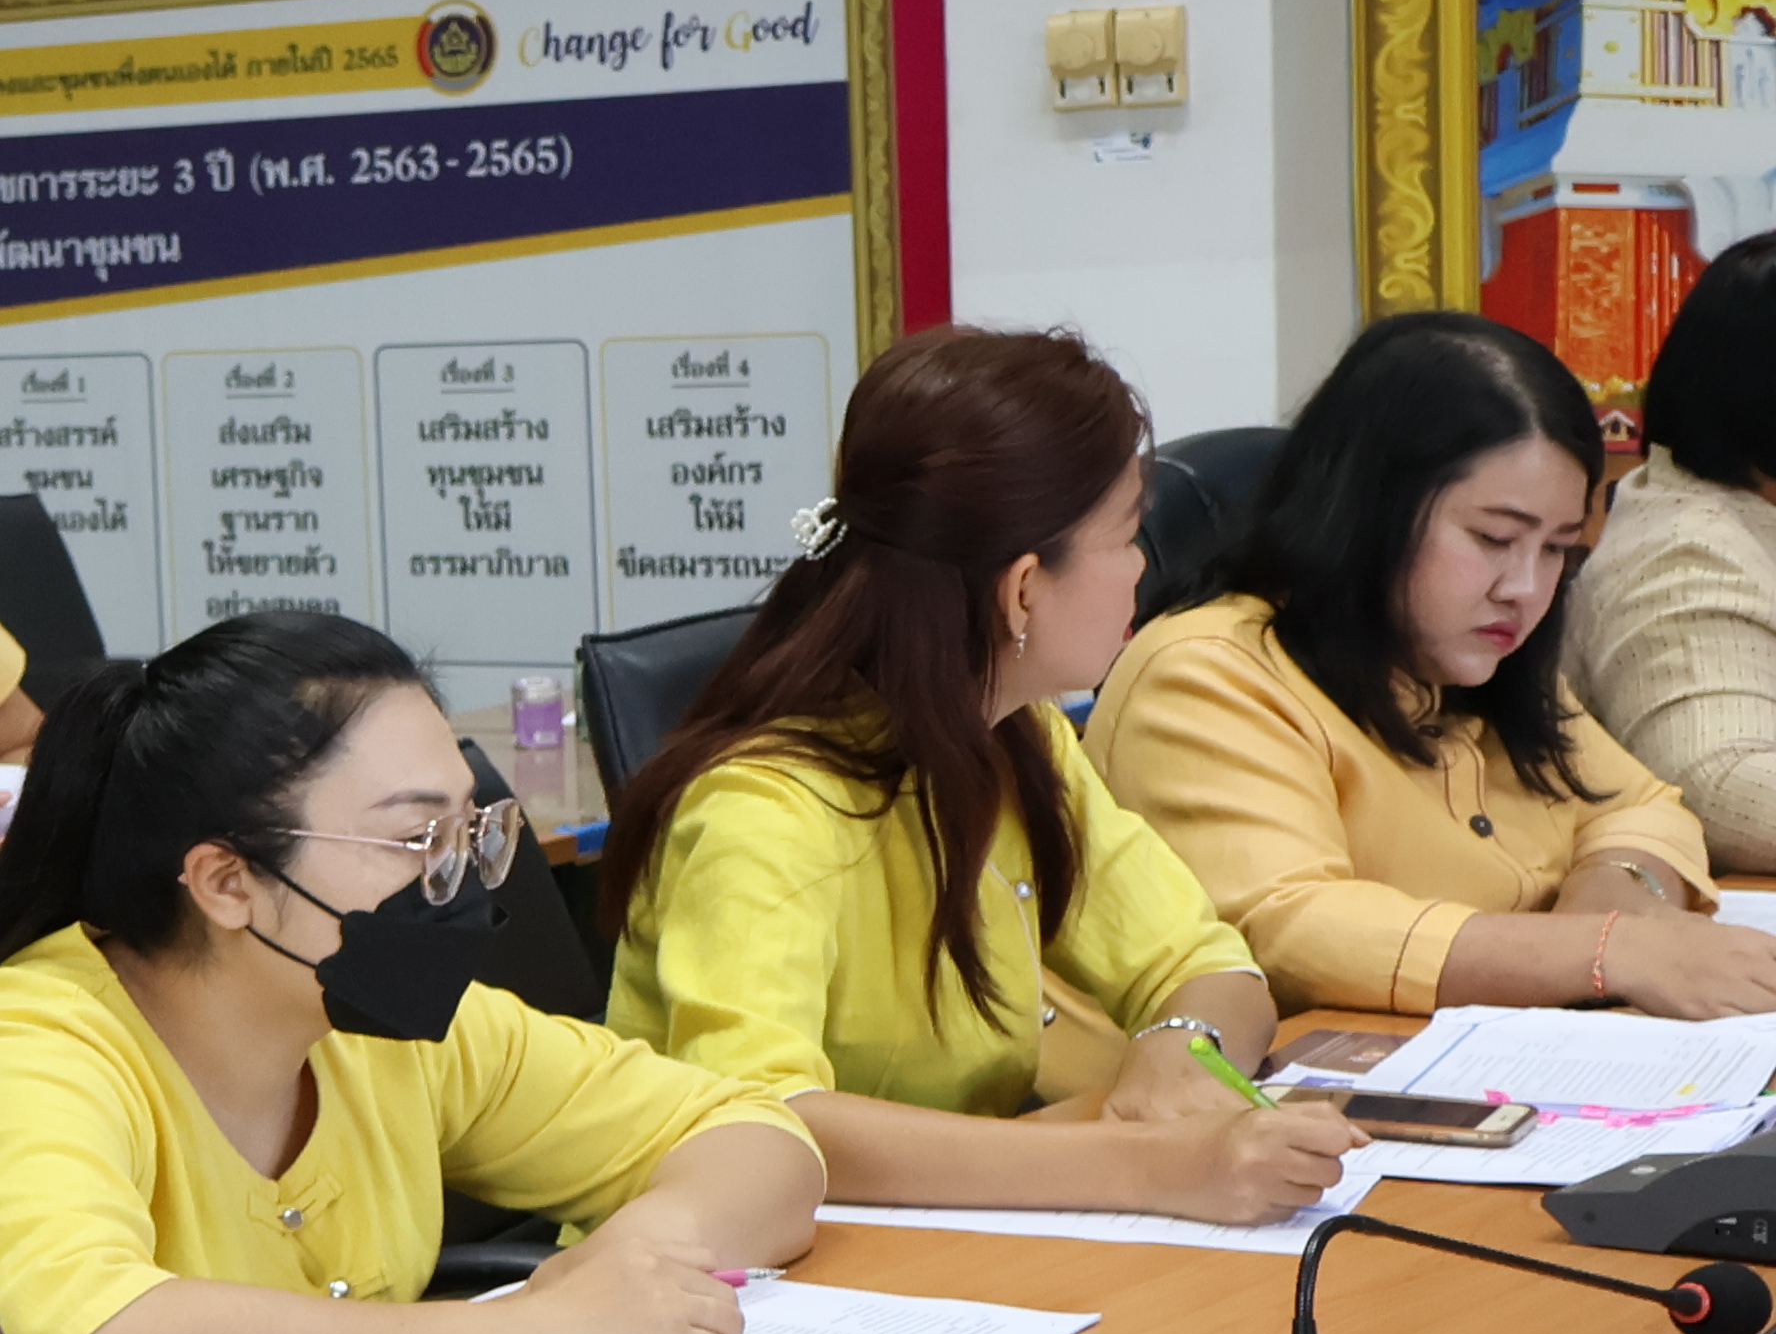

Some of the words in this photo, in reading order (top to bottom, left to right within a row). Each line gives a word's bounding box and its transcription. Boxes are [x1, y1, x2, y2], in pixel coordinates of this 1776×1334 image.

[516, 18, 652, 73] Change
[659, 9, 716, 72] for
[722, 0, 818, 53] Good
[342, 43, 400, 72] 2565
[172, 158, 197, 195] 3
[205, 145, 236, 193] ปี
[248, 147, 334, 200] (พ.ศ.
[503, 364, 515, 384] 3
[738, 358, 750, 378] 4
[217, 415, 311, 447] ส่งเสริม
[418, 407, 549, 444] เสริมสร้าง
[645, 403, 786, 440] เสริมสร้าง
[21, 466, 94, 495] ชุมชน
[211, 457, 323, 498] เศรษฐกิจ
[425, 459, 544, 501] ทุนชุมชน
[670, 452, 762, 487] องค์กร
[219, 509, 318, 542] ฐานราก
[457, 496, 512, 533] ให้มี
[688, 495, 745, 533] ให้มี
[202, 541, 337, 577] ให้ขยายตัว
[408, 546, 570, 579] ธรรมาภิบาล
